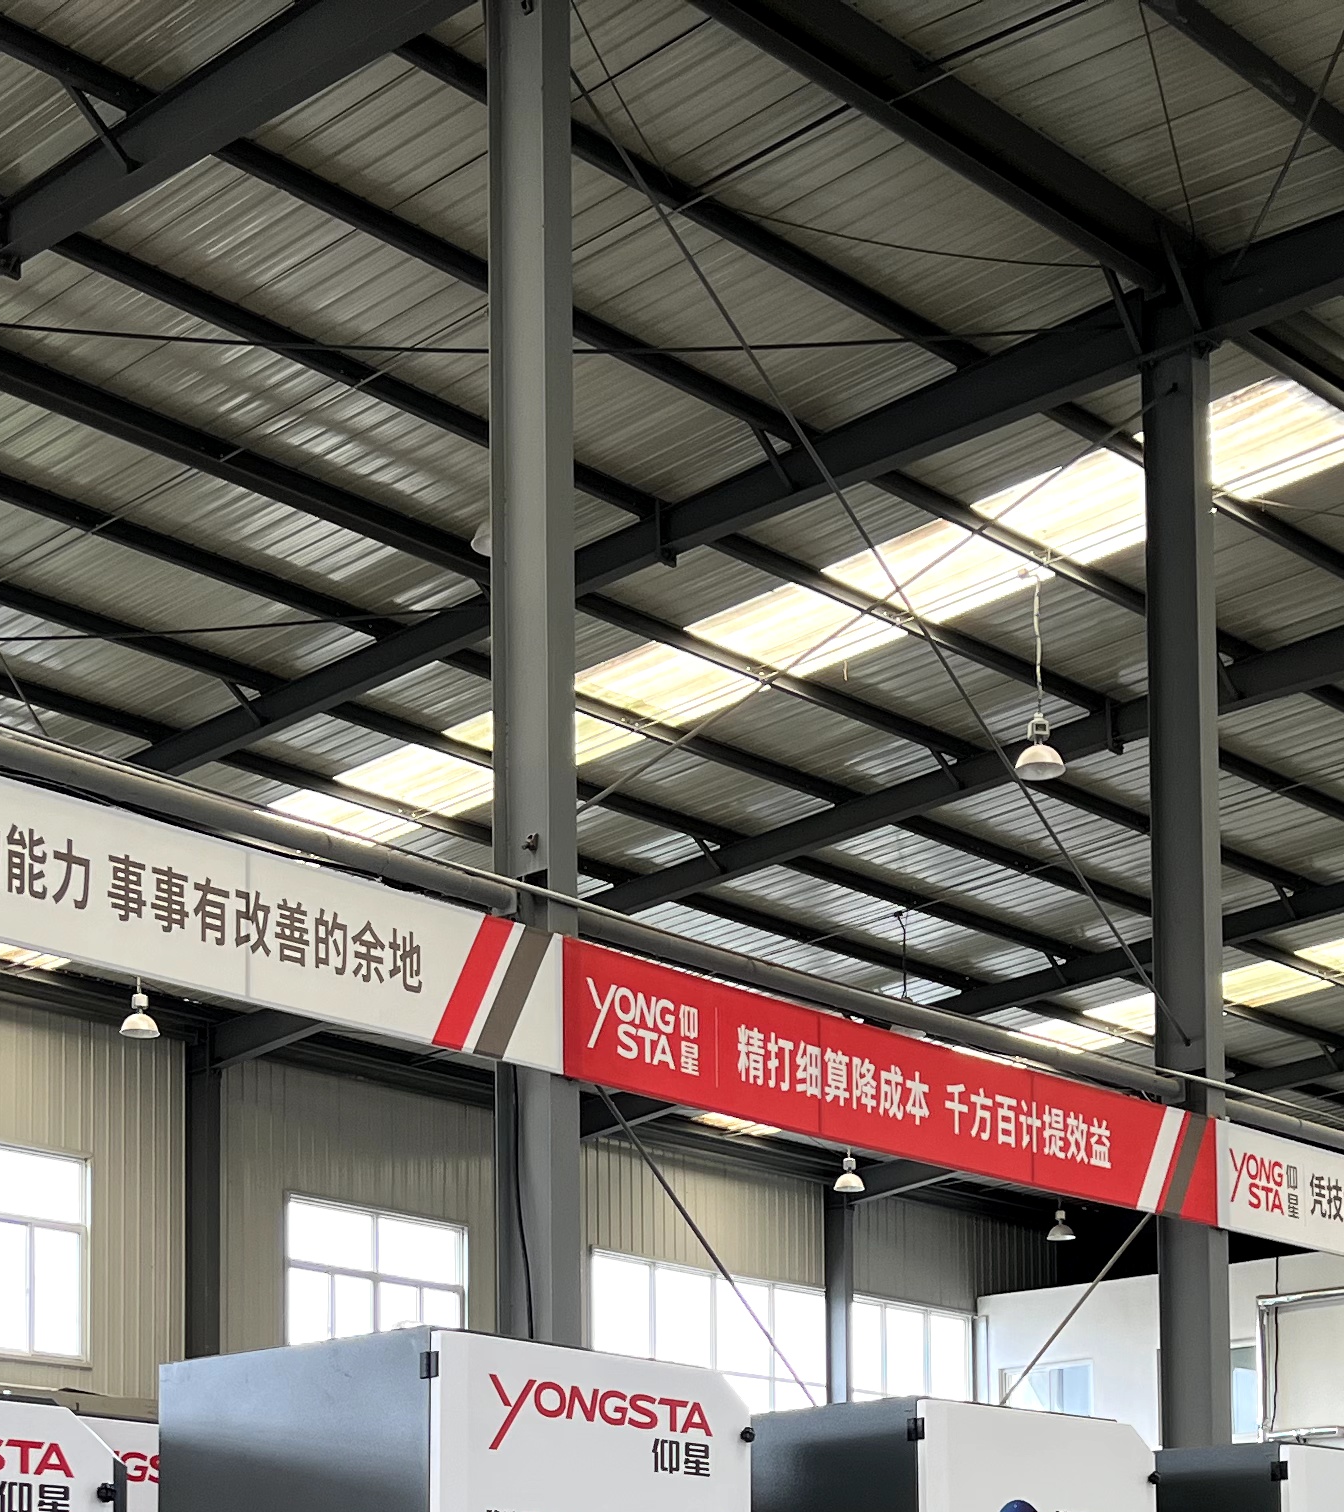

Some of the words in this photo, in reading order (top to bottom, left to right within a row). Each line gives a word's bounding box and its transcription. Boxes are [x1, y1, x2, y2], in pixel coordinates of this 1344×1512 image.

[107, 854, 423, 993] 事事有改善的余地
[586, 977, 676, 1048] YONG
[617, 1024, 674, 1071] STA
[679, 1003, 700, 1076] 仰星
[737, 1025, 930, 1125] 精打细算降成本
[945, 1083, 1112, 1169] 千方百计提效益
[1229, 1148, 1284, 1203] YONG
[1248, 1186, 1285, 1215] STA
[488, 1373, 713, 1450] YONGSTA
[651, 1438, 710, 1477] 仰星
